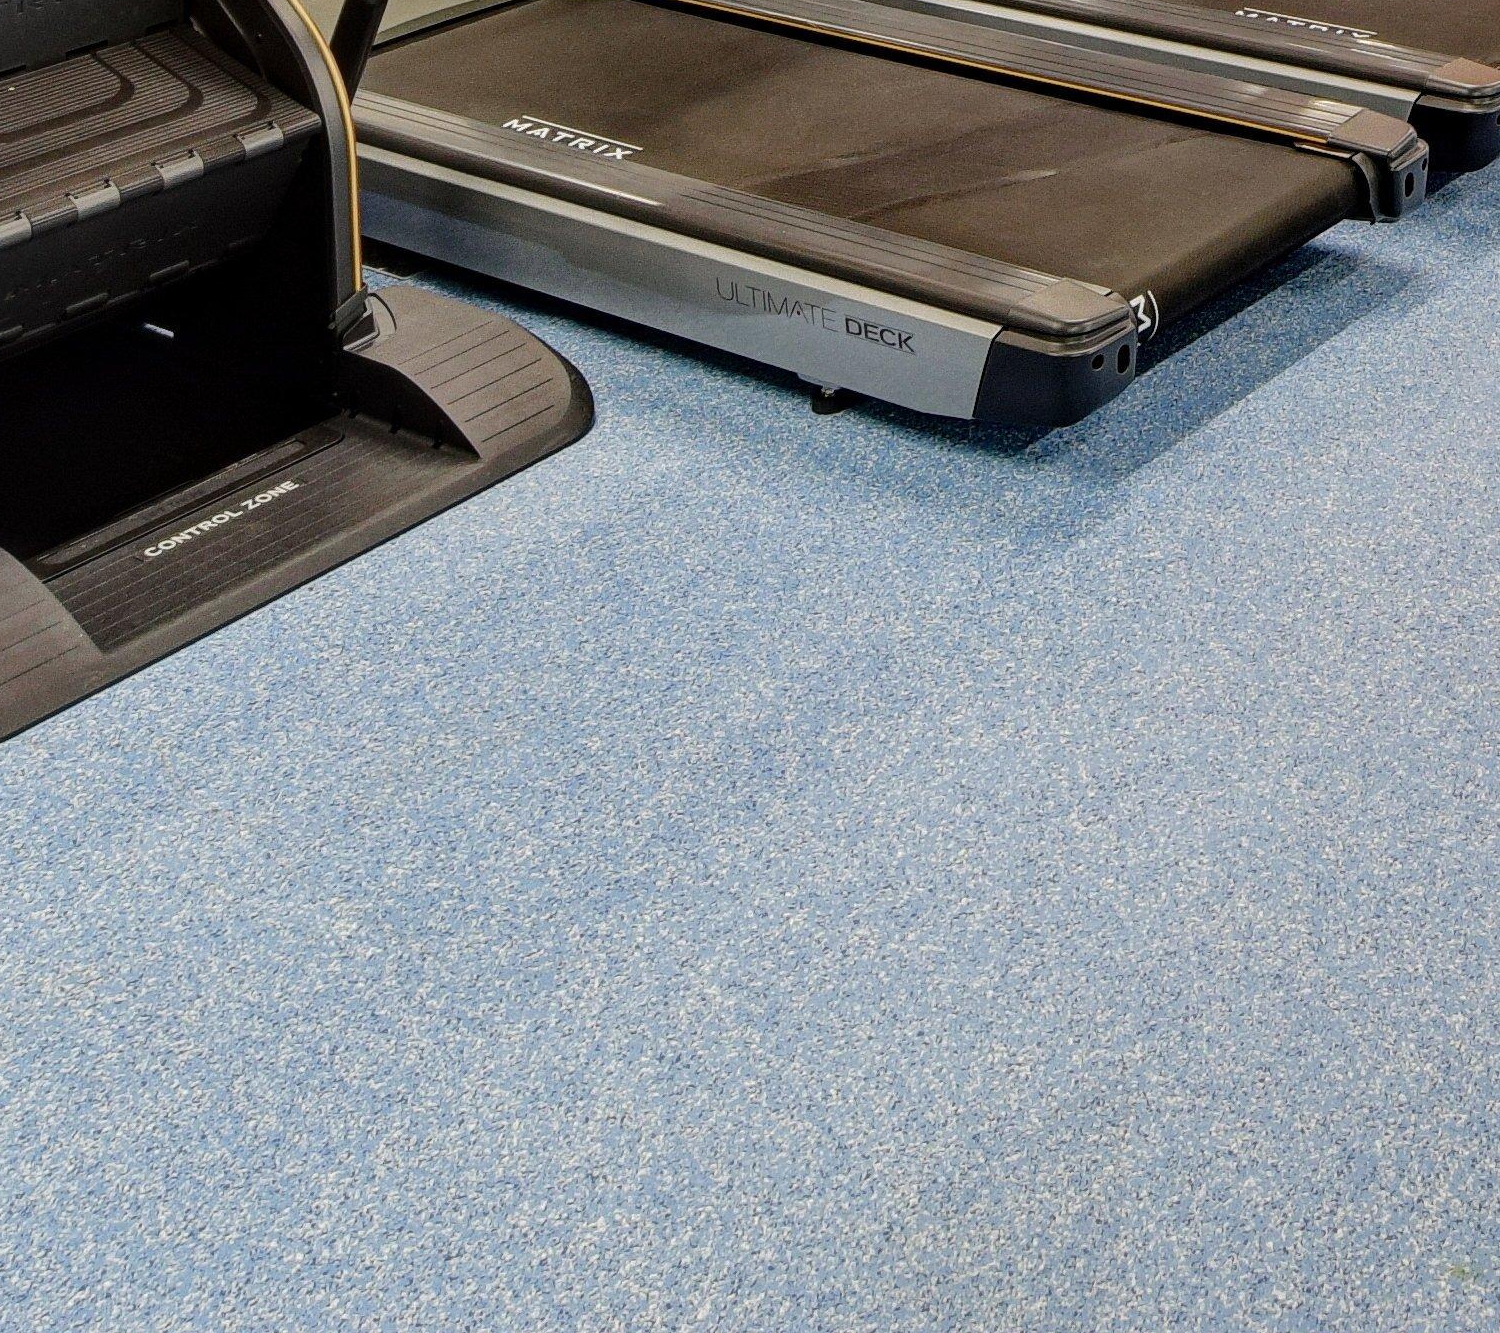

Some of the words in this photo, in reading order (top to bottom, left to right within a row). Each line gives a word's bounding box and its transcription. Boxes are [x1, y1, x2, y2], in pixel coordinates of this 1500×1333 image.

[501, 117, 637, 161] MATRIX
[715, 276, 838, 333] ULTIMATE
[843, 315, 916, 355] DECK
[143, 510, 244, 558] CONTROL
[239, 480, 300, 511] ZONE
